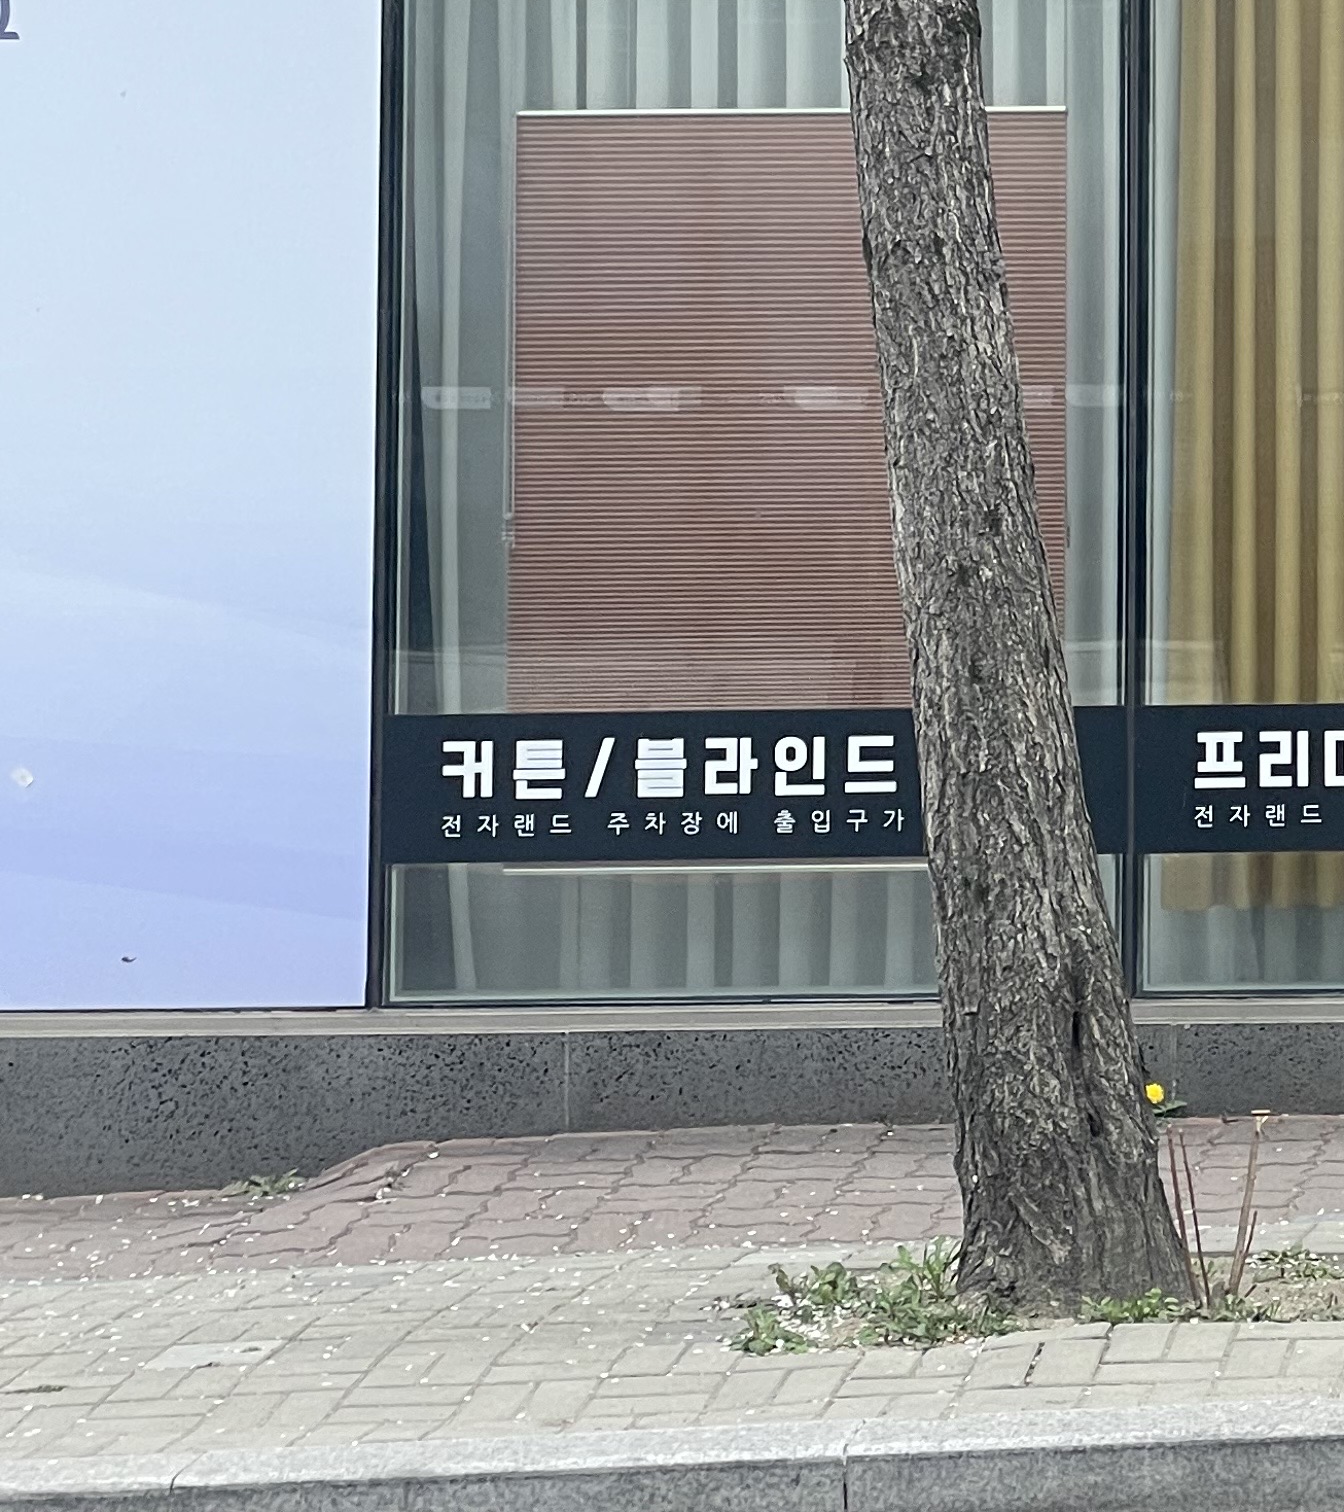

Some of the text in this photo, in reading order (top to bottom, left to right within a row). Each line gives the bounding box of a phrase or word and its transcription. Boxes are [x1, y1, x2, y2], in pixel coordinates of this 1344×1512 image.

[442, 735, 897, 800] 커튼/블라인드
[441, 808, 905, 838] 전자랜드 주차장에 출입구가
[1194, 803, 1322, 828] 전자랜드
